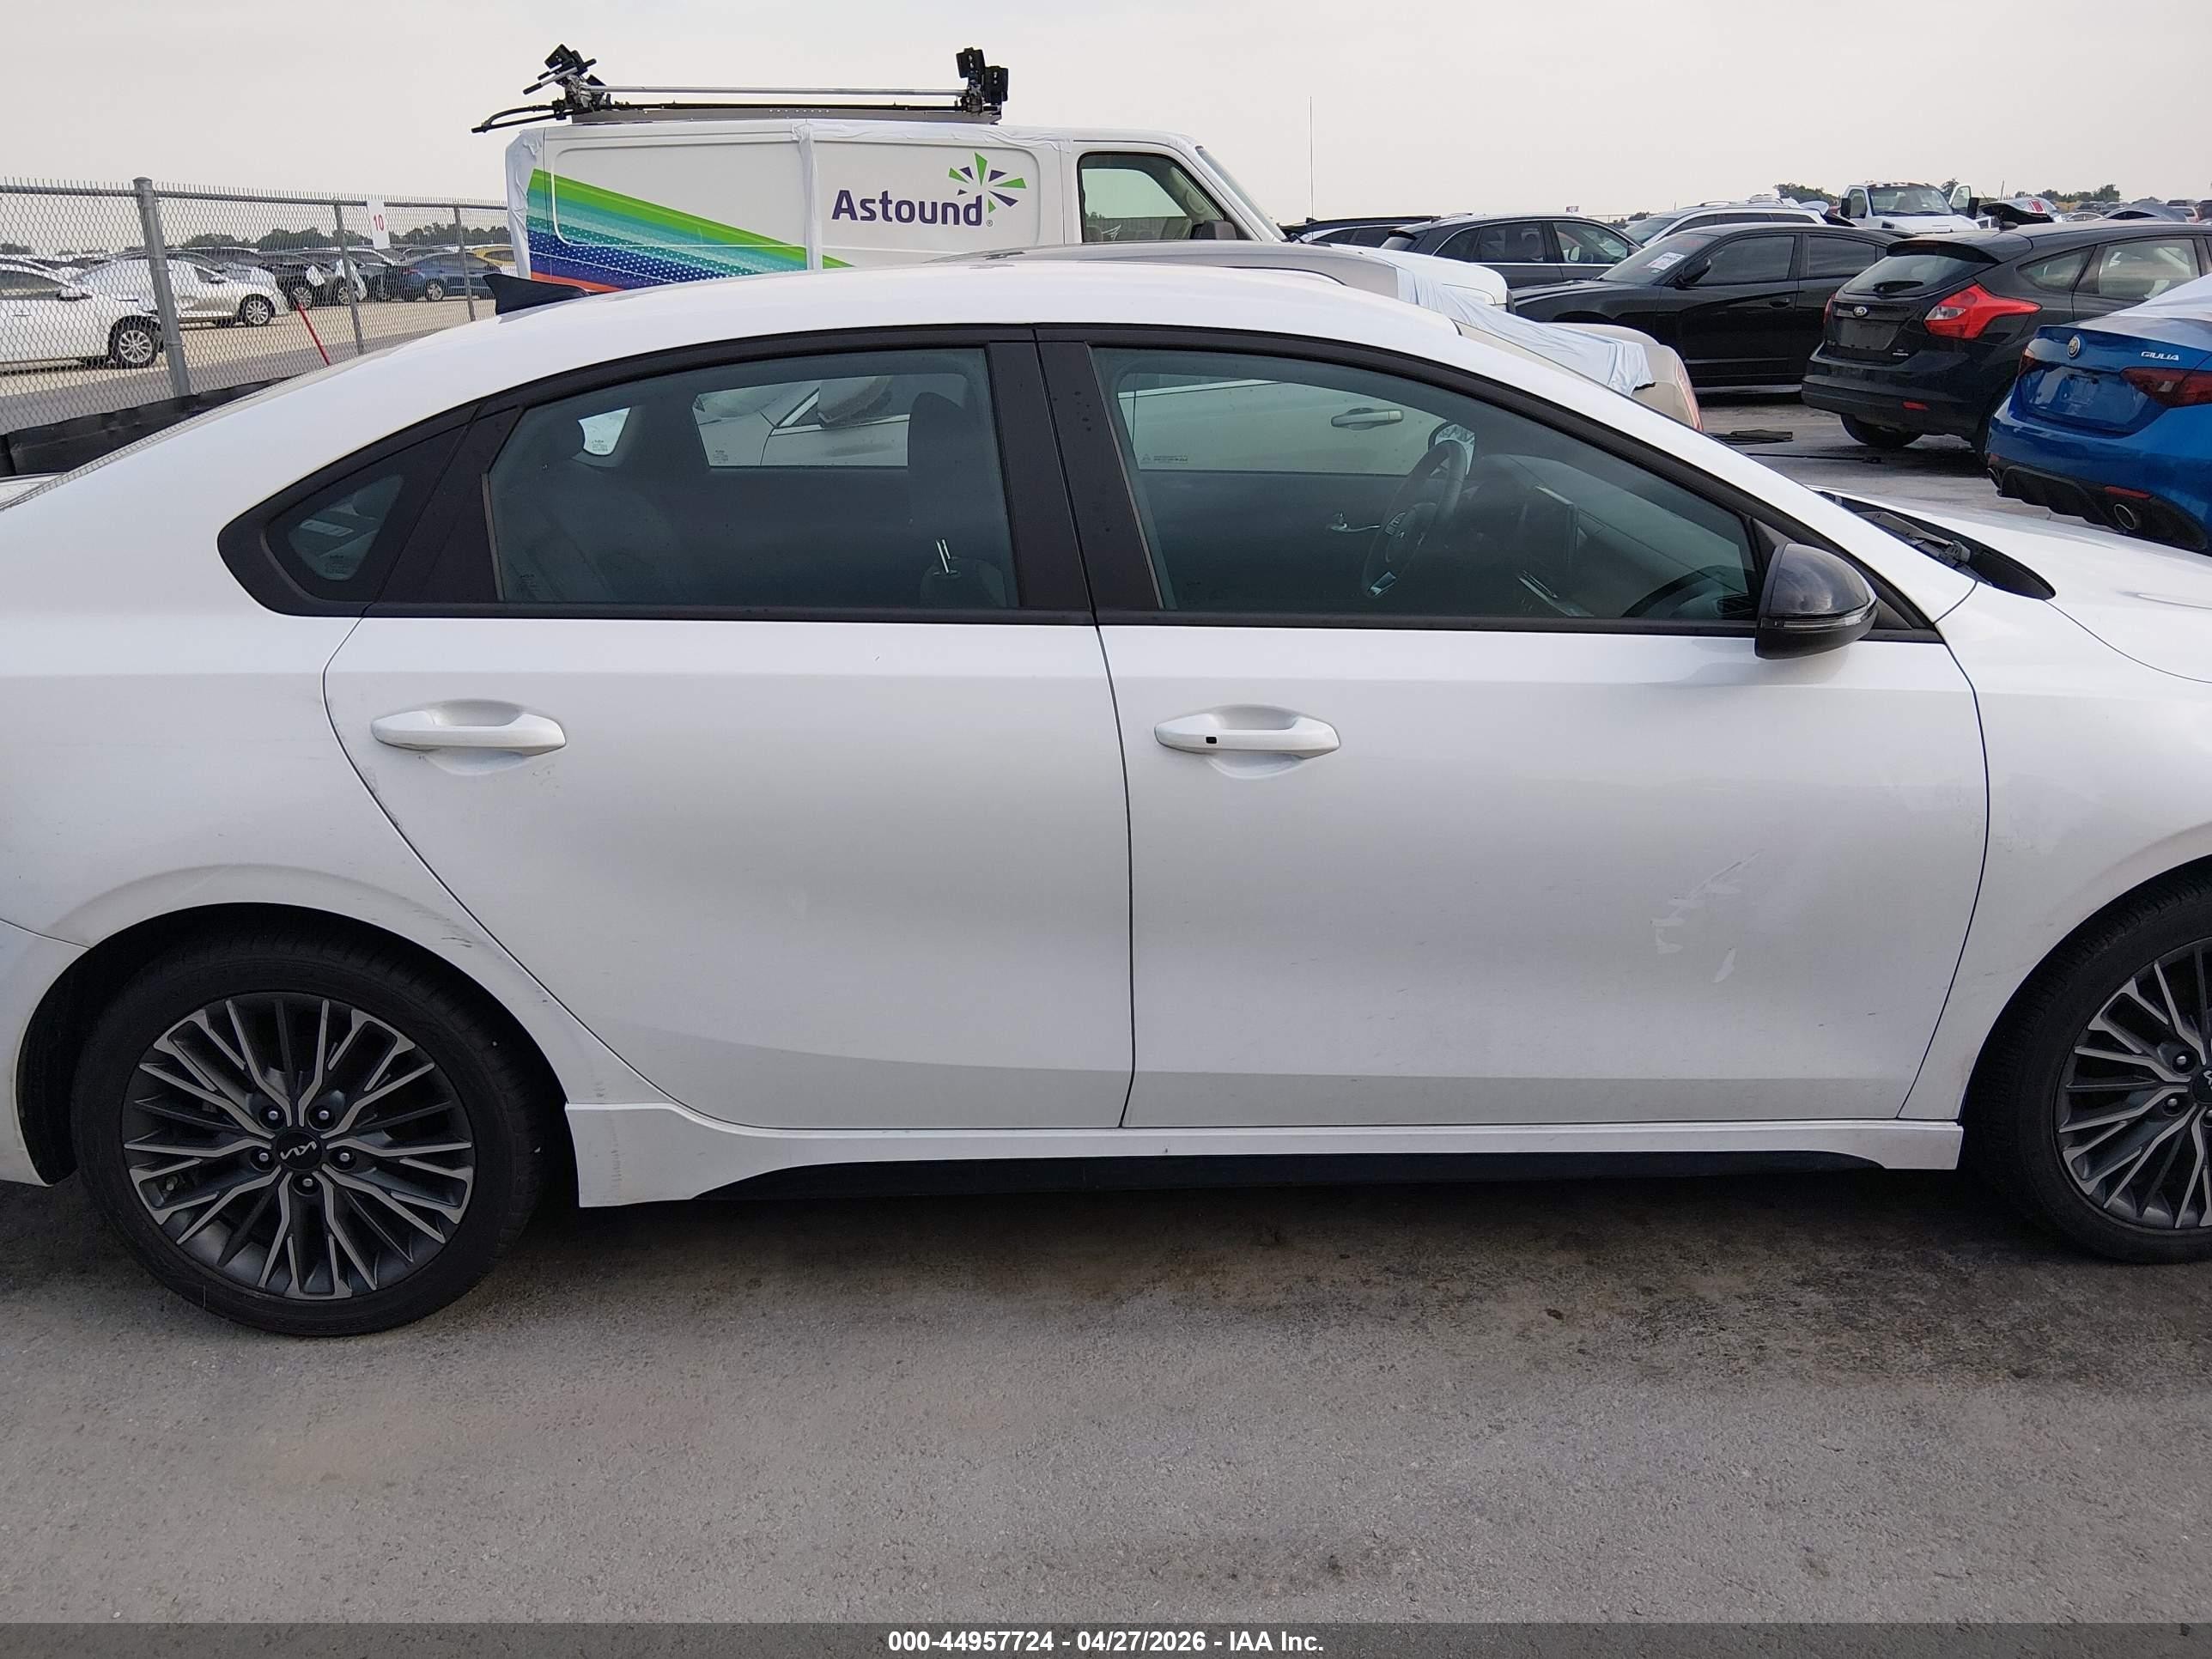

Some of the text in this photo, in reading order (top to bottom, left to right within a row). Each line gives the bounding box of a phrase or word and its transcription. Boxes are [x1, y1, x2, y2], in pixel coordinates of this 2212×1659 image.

[831, 189, 982, 226] Astound
[373, 214, 385, 232] 10
[2141, 350, 2179, 362] GIULIA
